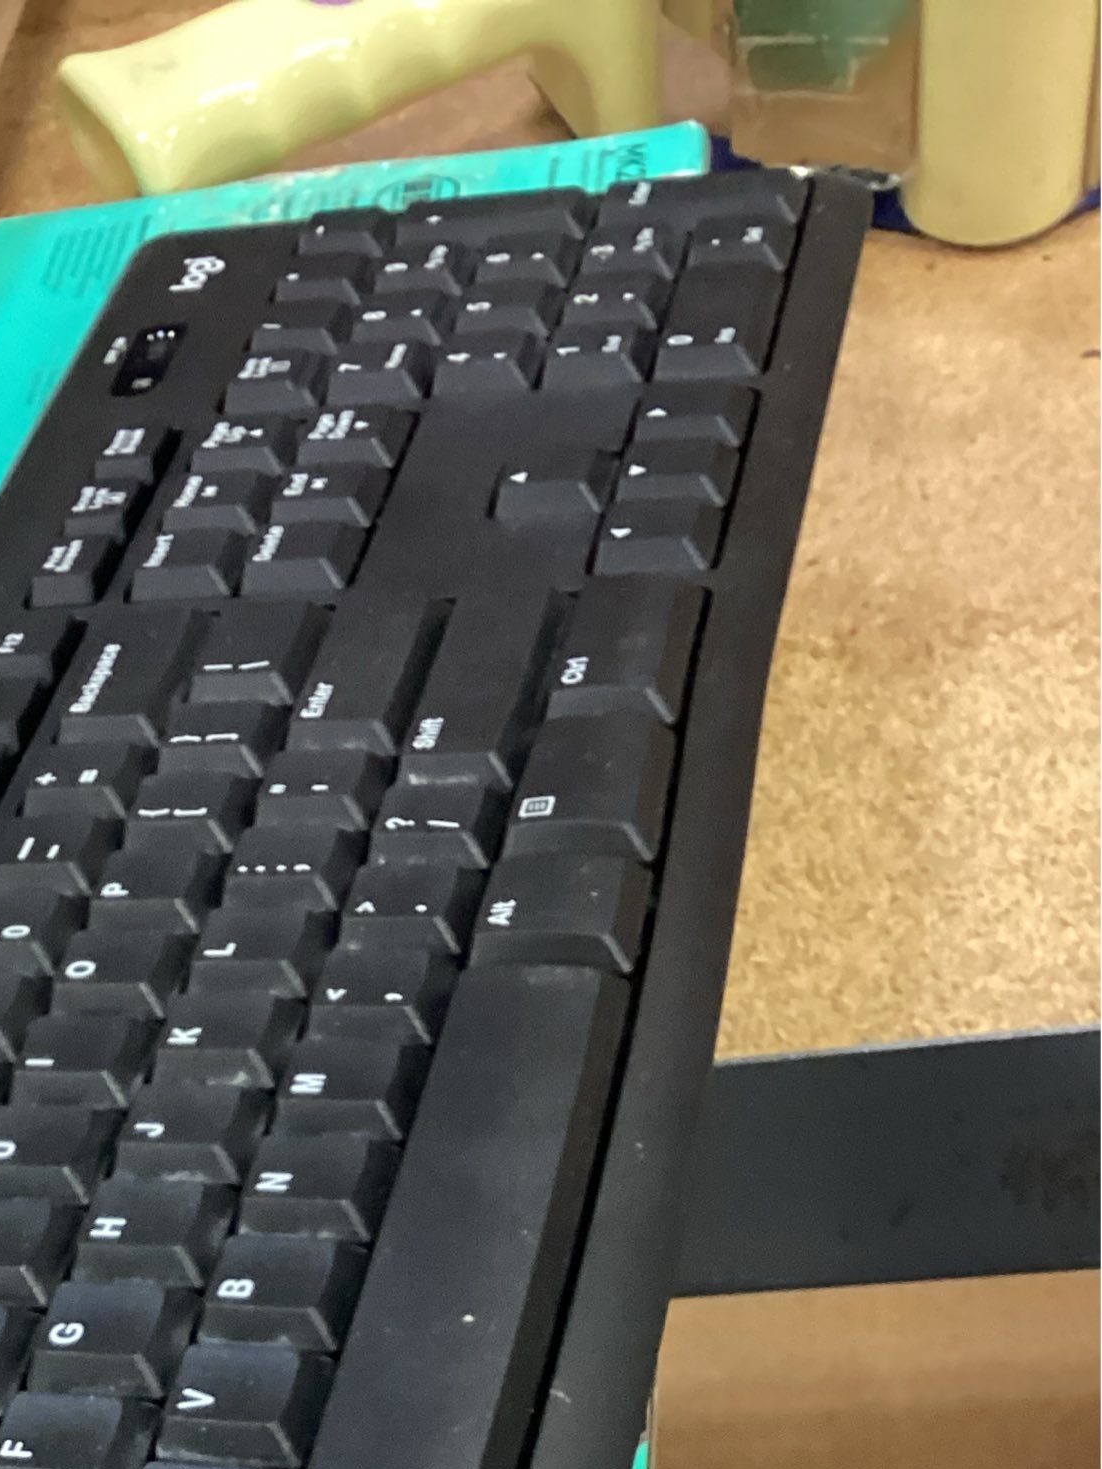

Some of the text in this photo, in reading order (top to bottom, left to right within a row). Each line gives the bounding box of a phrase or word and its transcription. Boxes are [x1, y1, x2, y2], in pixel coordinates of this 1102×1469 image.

[169, 257, 225, 291] logi
[69, 644, 120, 713] Backspace
[561, 657, 588, 684] Ctrl
[300, 683, 333, 718] Enter
[412, 717, 443, 749] Shift
[101, 883, 128, 897] P
[488, 900, 516, 925] Alt
[1, 924, 31, 939] 0
[203, 942, 237, 957] L
[65, 961, 96, 978] O
[167, 1028, 202, 1044] K
[24, 1058, 55, 1067] I
[290, 1074, 326, 1093] M
[134, 1123, 164, 1137] J
[255, 1172, 293, 1191] N
[90, 1218, 126, 1237] H
[217, 1279, 254, 1298] B
[49, 1323, 84, 1345] G
[177, 1389, 214, 1409] V
[0, 1440, 32, 1458] F
